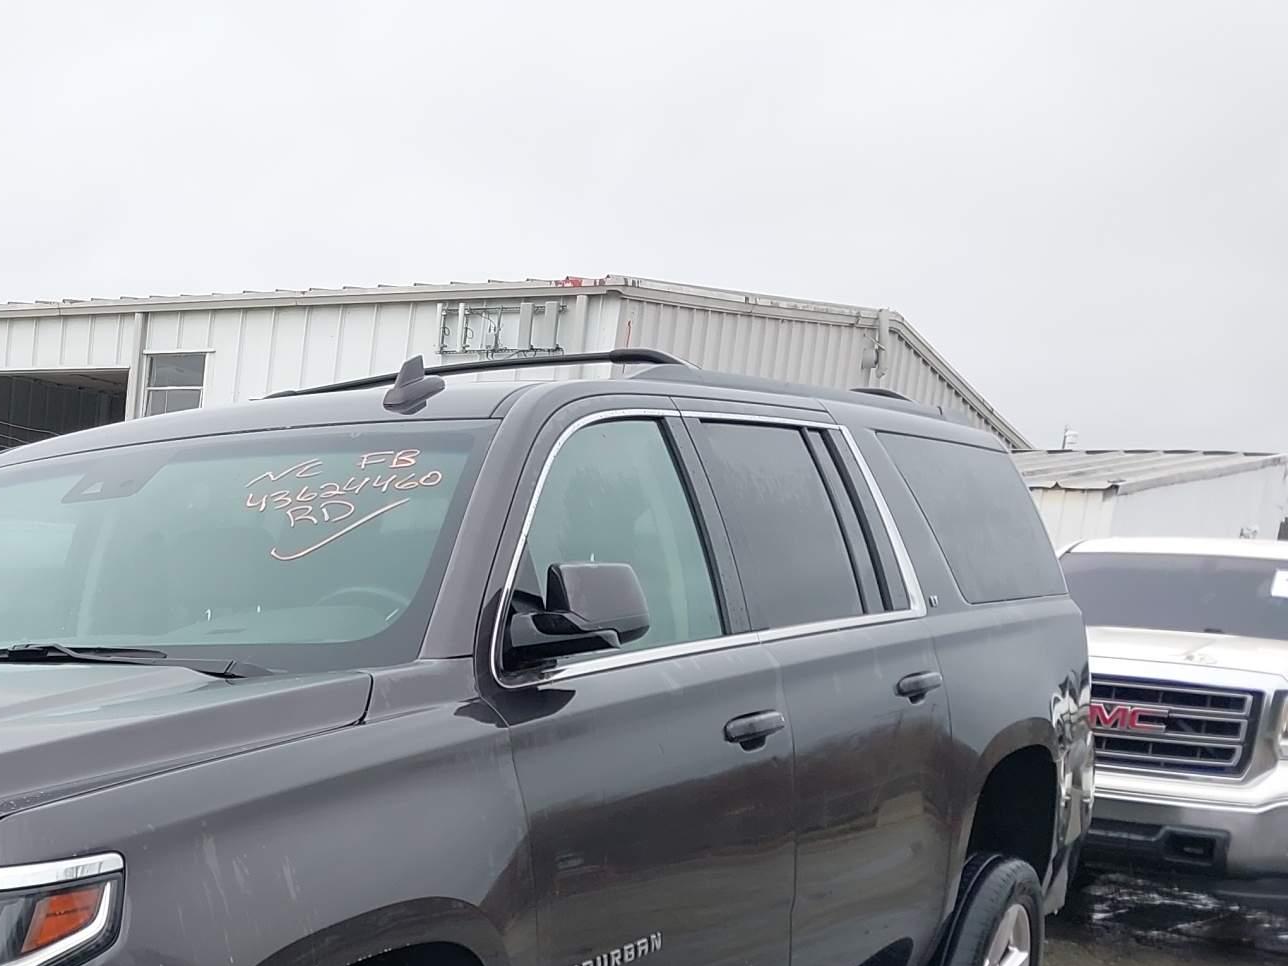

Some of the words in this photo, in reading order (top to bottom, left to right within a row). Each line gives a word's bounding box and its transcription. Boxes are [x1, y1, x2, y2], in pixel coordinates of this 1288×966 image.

[358, 449, 421, 469] FB
[245, 470, 443, 512] 43624460
[286, 499, 355, 527] RD
[1088, 703, 1168, 732] MC
